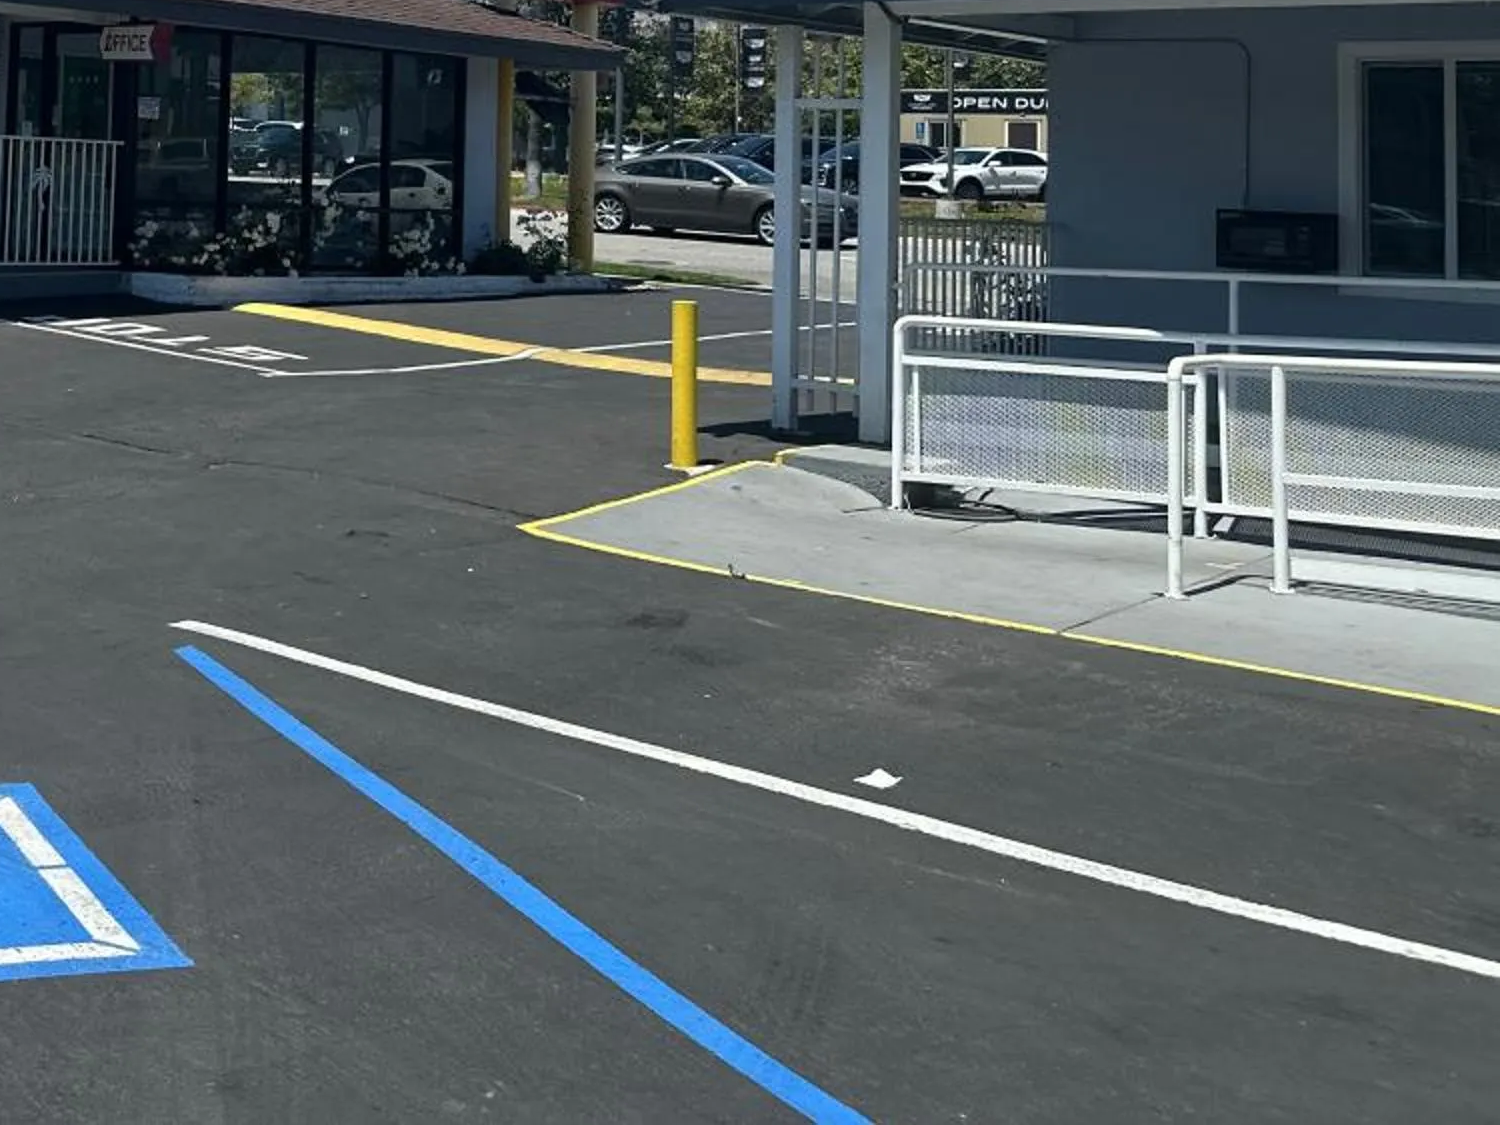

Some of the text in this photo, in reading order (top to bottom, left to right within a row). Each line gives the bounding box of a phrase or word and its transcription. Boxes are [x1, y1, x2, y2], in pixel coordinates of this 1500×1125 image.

[103, 33, 149, 52] OFFICE
[953, 96, 1007, 109] OPEN
[1014, 96, 1049, 109] DU
